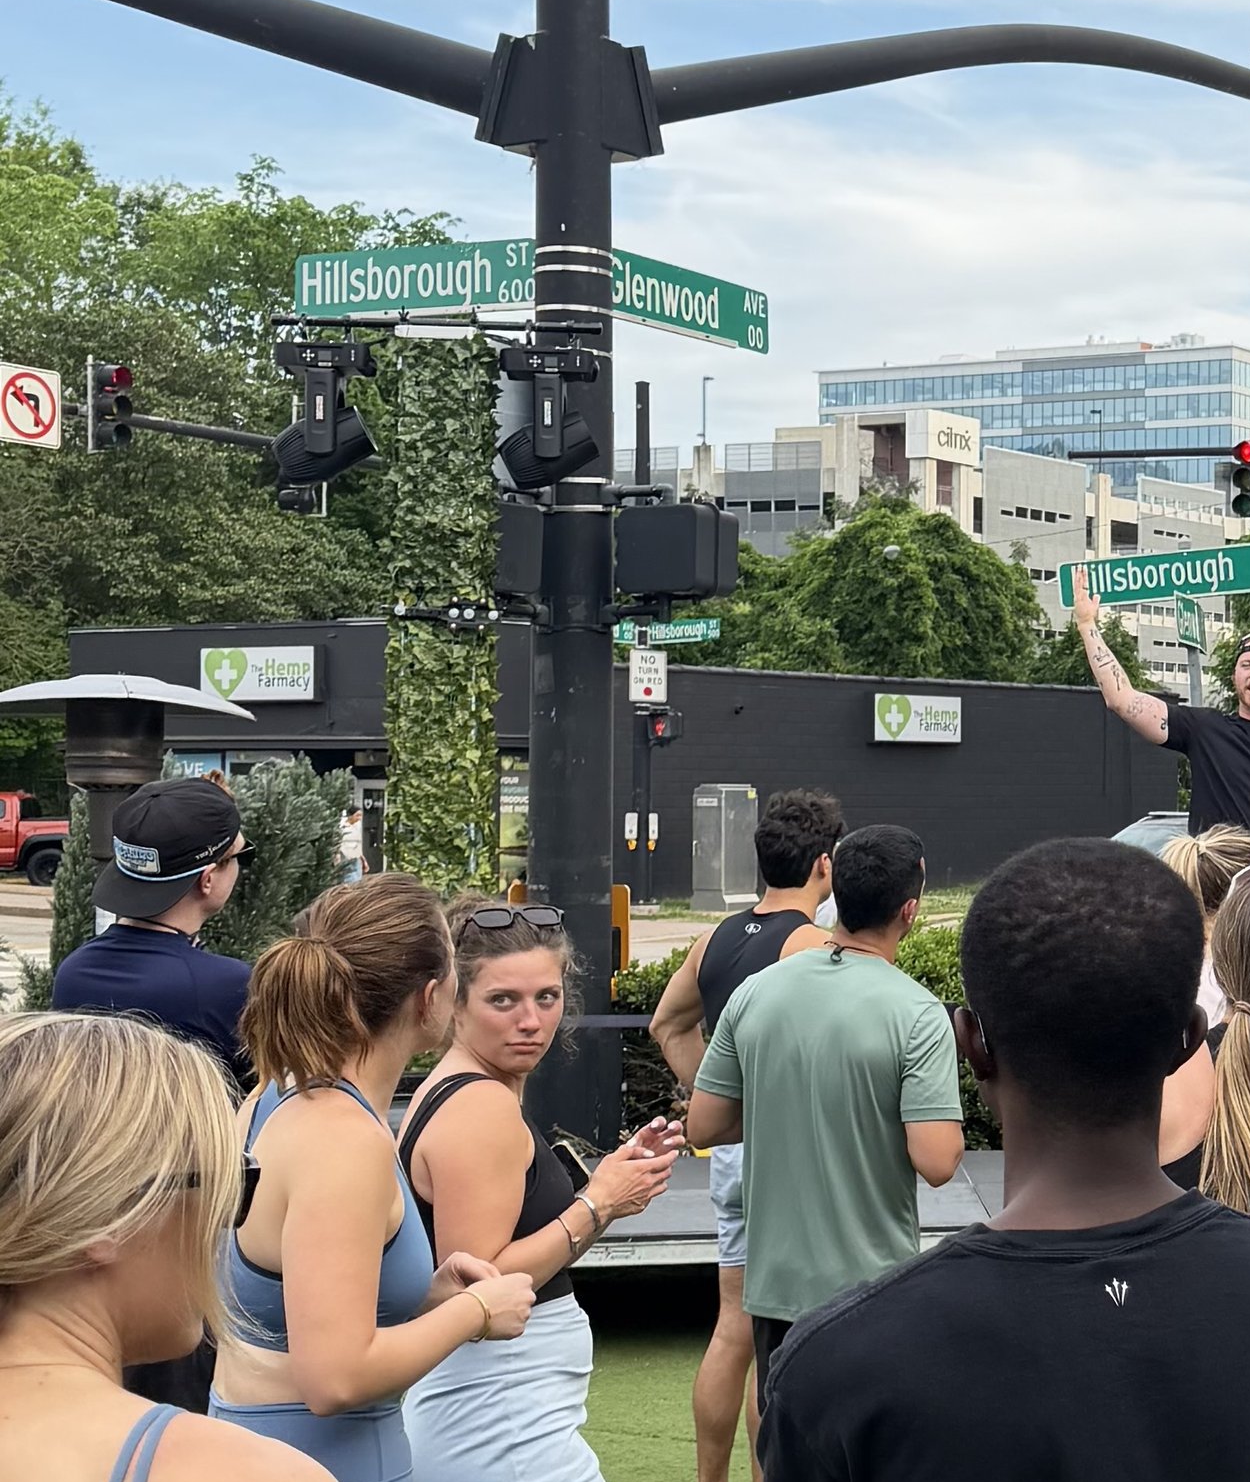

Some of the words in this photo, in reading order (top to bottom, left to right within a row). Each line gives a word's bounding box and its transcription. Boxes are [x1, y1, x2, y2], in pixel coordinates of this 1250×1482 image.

[506, 241, 529, 267] ST
[302, 249, 492, 306] Hillsborough
[498, 278, 536, 303] 600
[612, 256, 719, 330] Glenwood
[743, 290, 767, 319] AVE
[747, 324, 764, 349] 00
[937, 426, 971, 452] citrix
[651, 621, 707, 640] Hillsborough
[251, 664, 263, 673] The
[265, 658, 311, 676] Hemp
[640, 655, 656, 664] NO
[258, 674, 311, 691] Farmacy
[924, 706, 958, 722] Hemp
[920, 719, 958, 735] Farmacy
